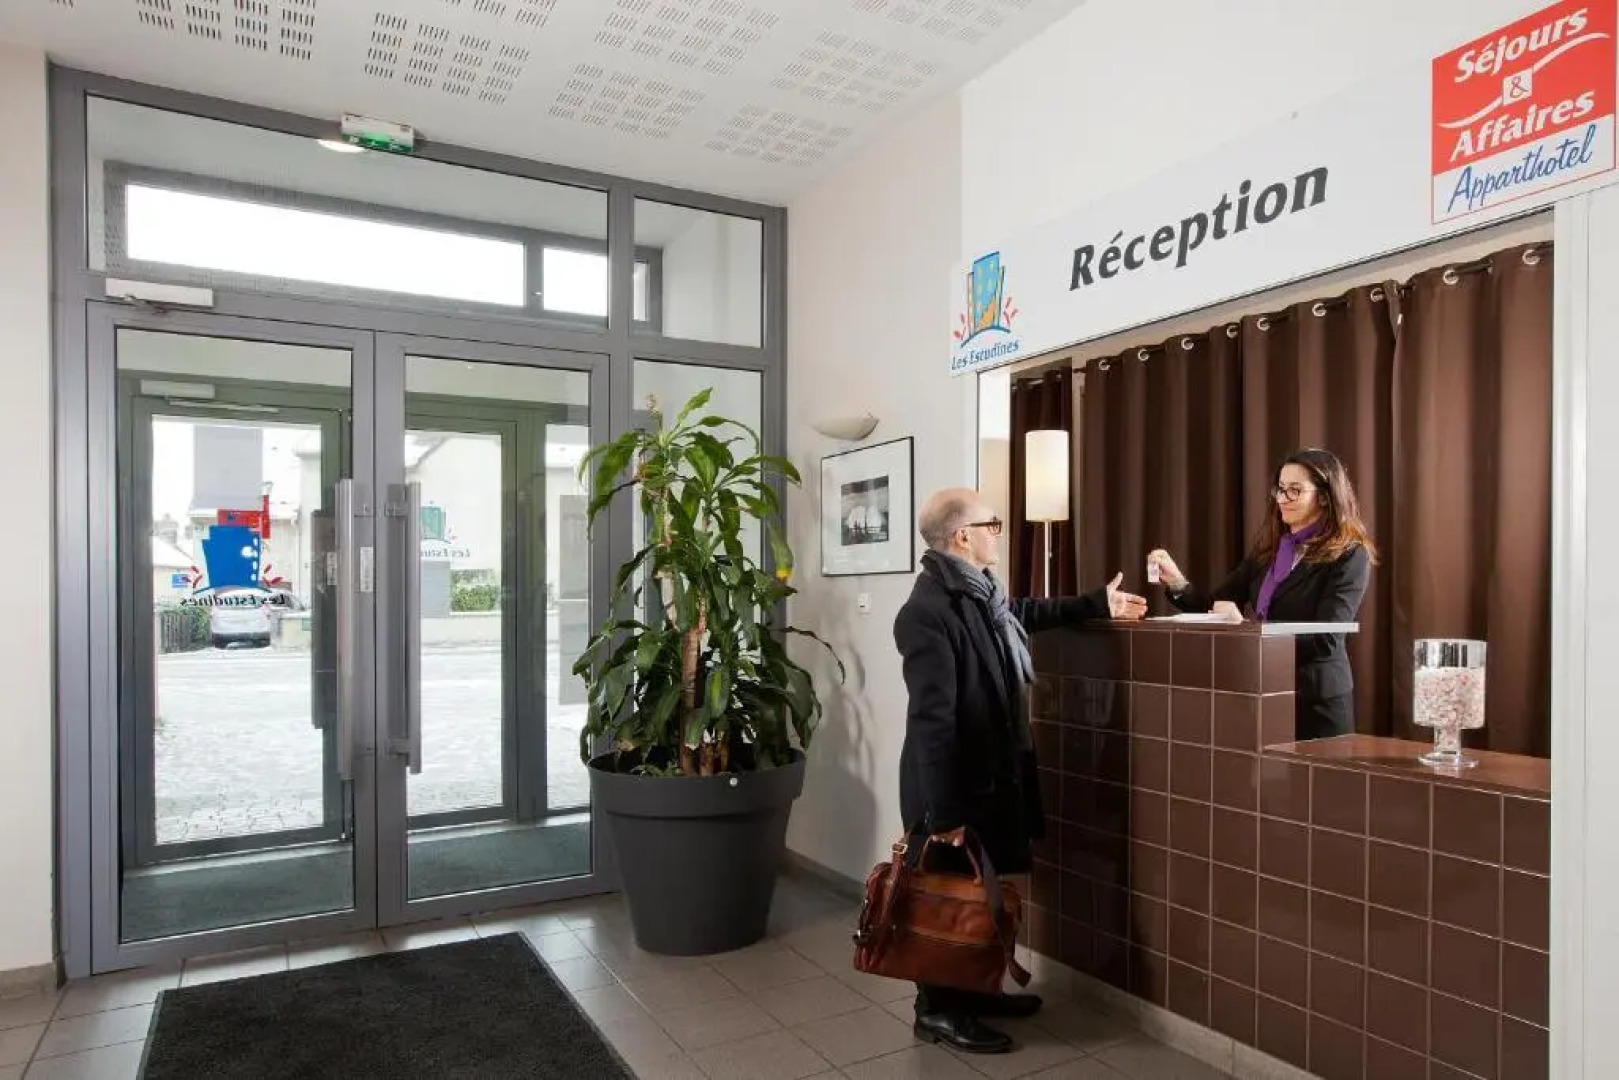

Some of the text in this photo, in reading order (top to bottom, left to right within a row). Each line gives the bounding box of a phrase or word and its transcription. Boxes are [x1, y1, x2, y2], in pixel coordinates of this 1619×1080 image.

[1454, 8, 1588, 83] Séjours
[1509, 75, 1529, 98] &
[1450, 90, 1595, 162] Affaires
[1447, 124, 1596, 212] Apparthotel
[1069, 167, 1328, 291] Réception
[951, 340, 1019, 371] Les Estudines
